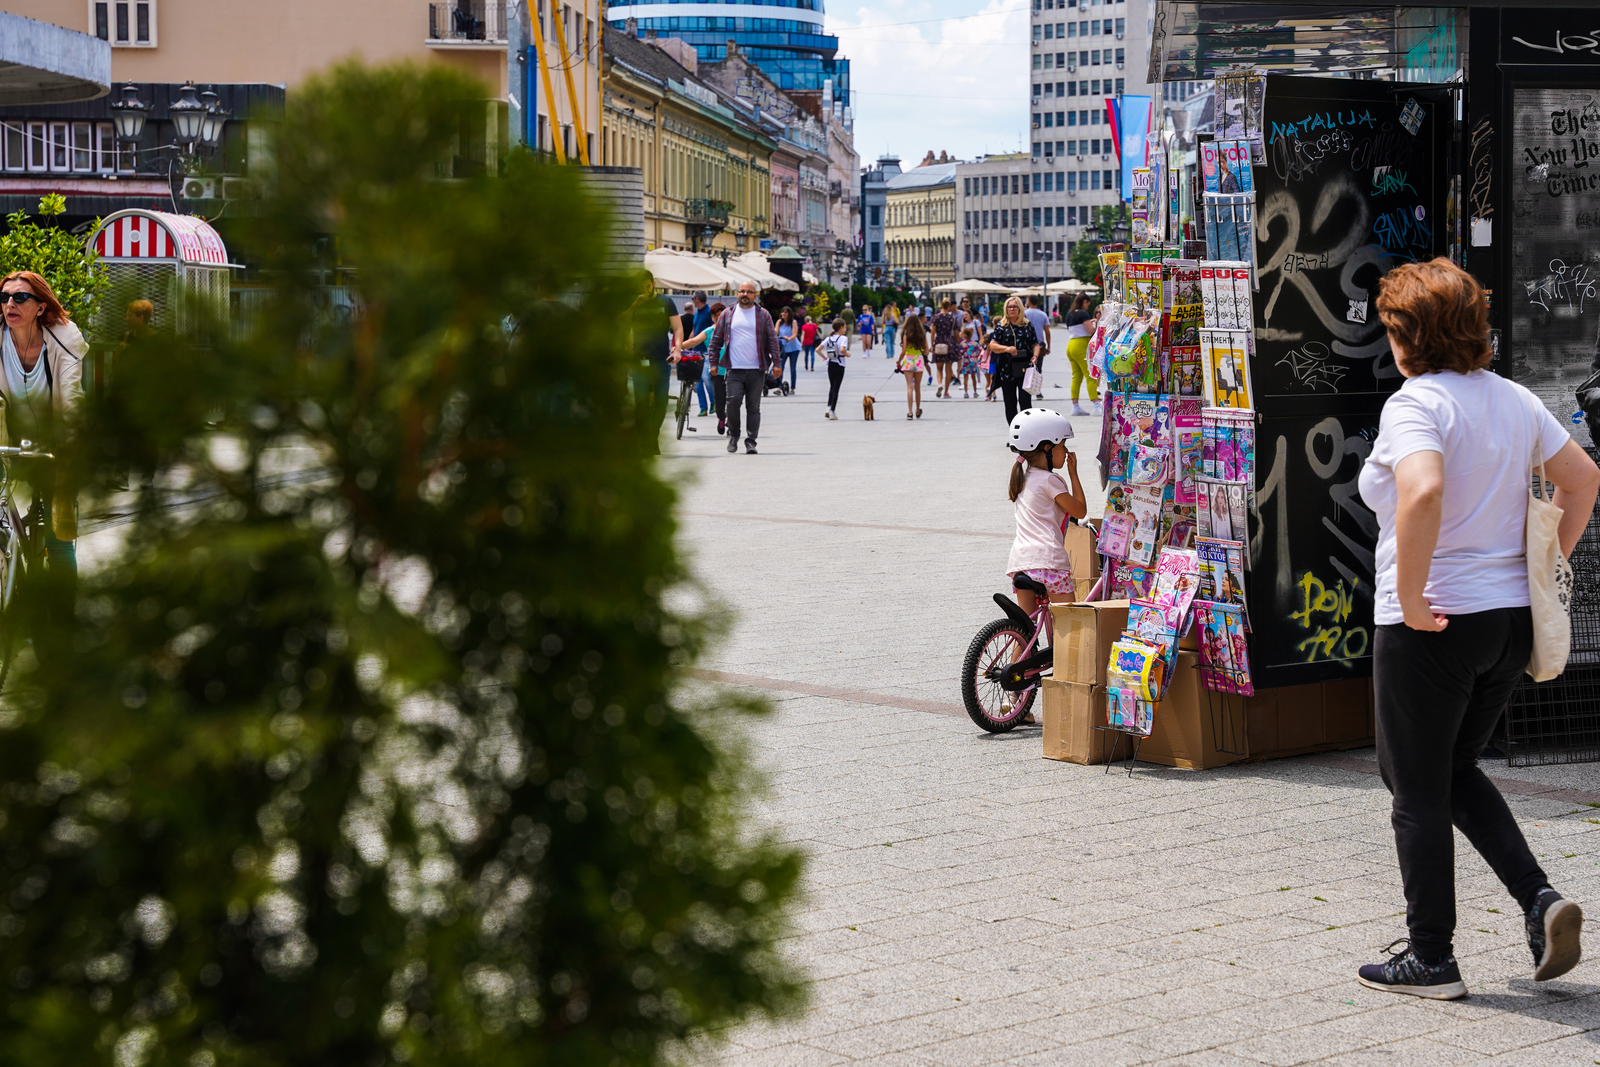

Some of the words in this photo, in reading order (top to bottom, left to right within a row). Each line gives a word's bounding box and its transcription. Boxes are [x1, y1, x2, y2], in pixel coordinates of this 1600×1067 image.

[1269, 109, 1377, 145] NATALIJA
[1551, 109, 1589, 136] The
[1204, 143, 1247, 163] burda
[1571, 138, 1600, 169] Yo
[1547, 172, 1600, 198] Time
[1205, 196, 1252, 223] ELLE
[1201, 269, 1249, 280] BUG
[1177, 305, 1202, 313] ALAN
[1228, 498, 1244, 509] tyle
[1118, 651, 1134, 669] Peppa
[1134, 654, 1144, 672] Pig
